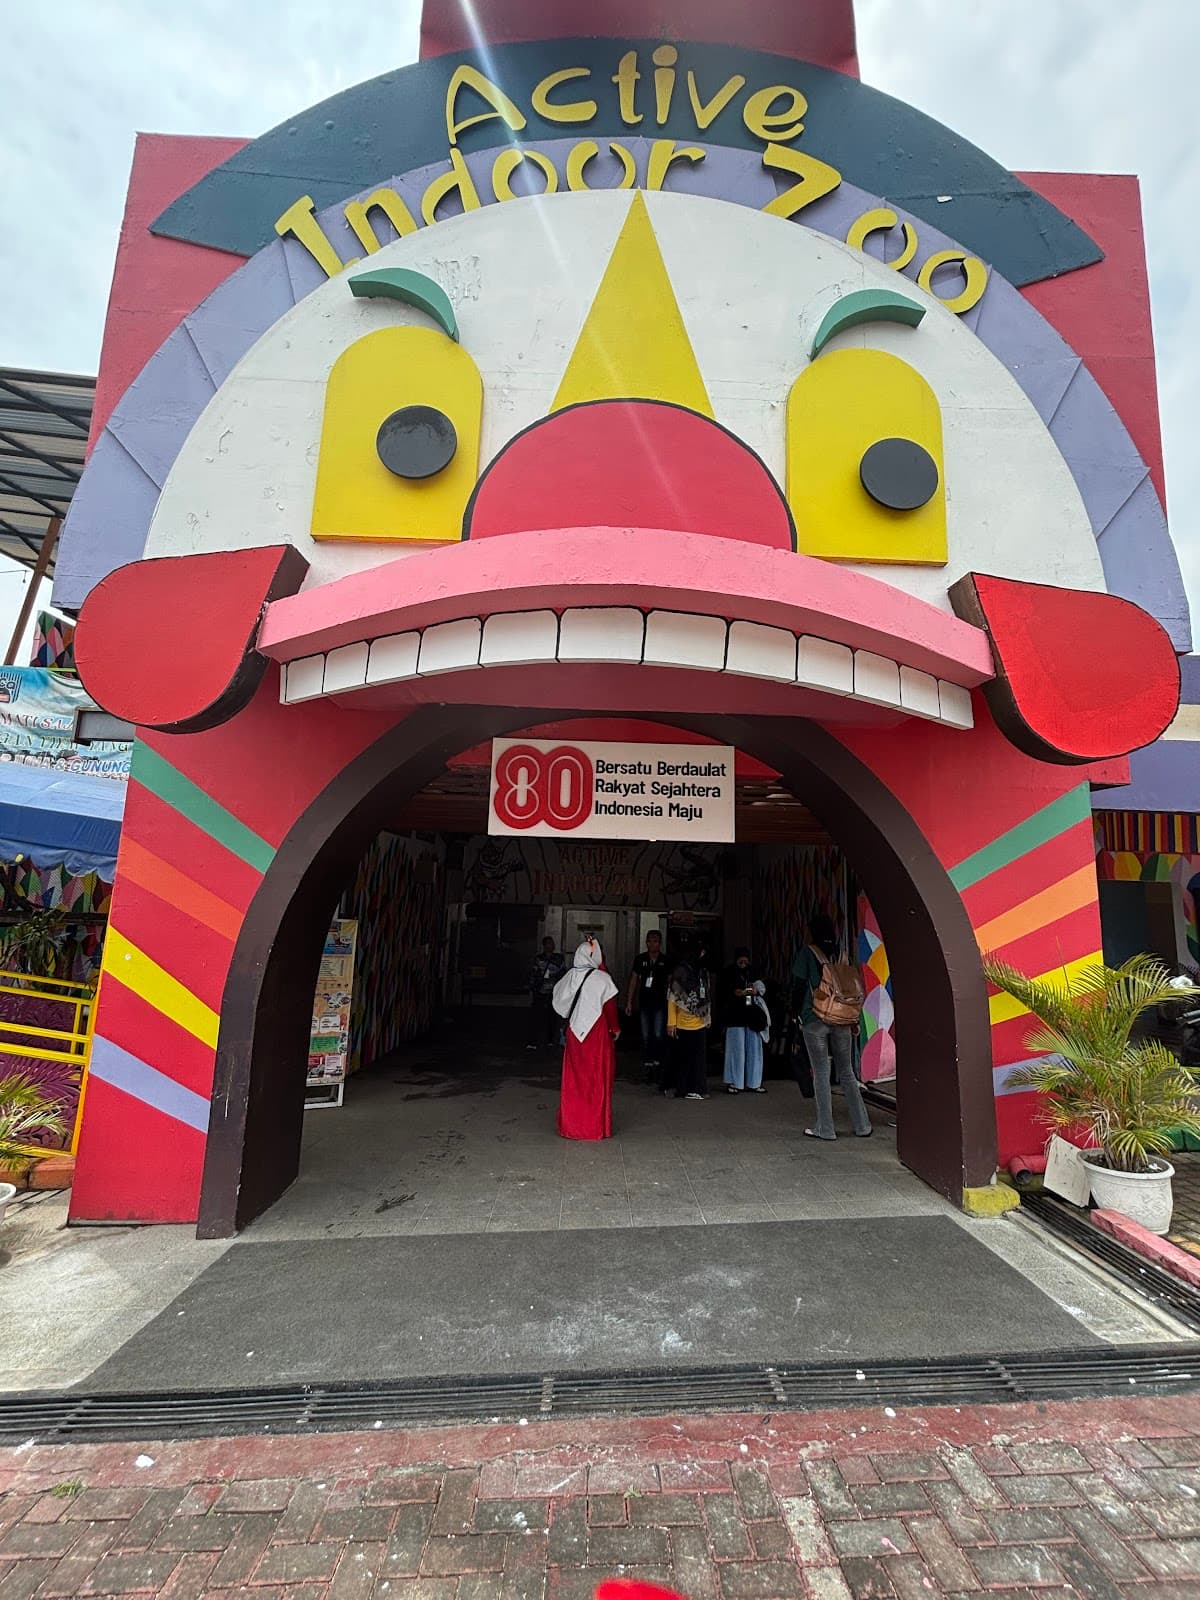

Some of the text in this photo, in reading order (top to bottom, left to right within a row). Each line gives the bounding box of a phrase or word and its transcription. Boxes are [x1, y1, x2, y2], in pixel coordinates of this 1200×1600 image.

[445, 44, 808, 145] Active
[275, 138, 989, 315] Indoor Zoo
[494, 744, 593, 831] 80
[595, 759, 727, 777] Bersatu Berdaulat
[595, 778, 721, 799] Rakyat Sejahtera
[594, 800, 703, 822] Indonesia Maju
